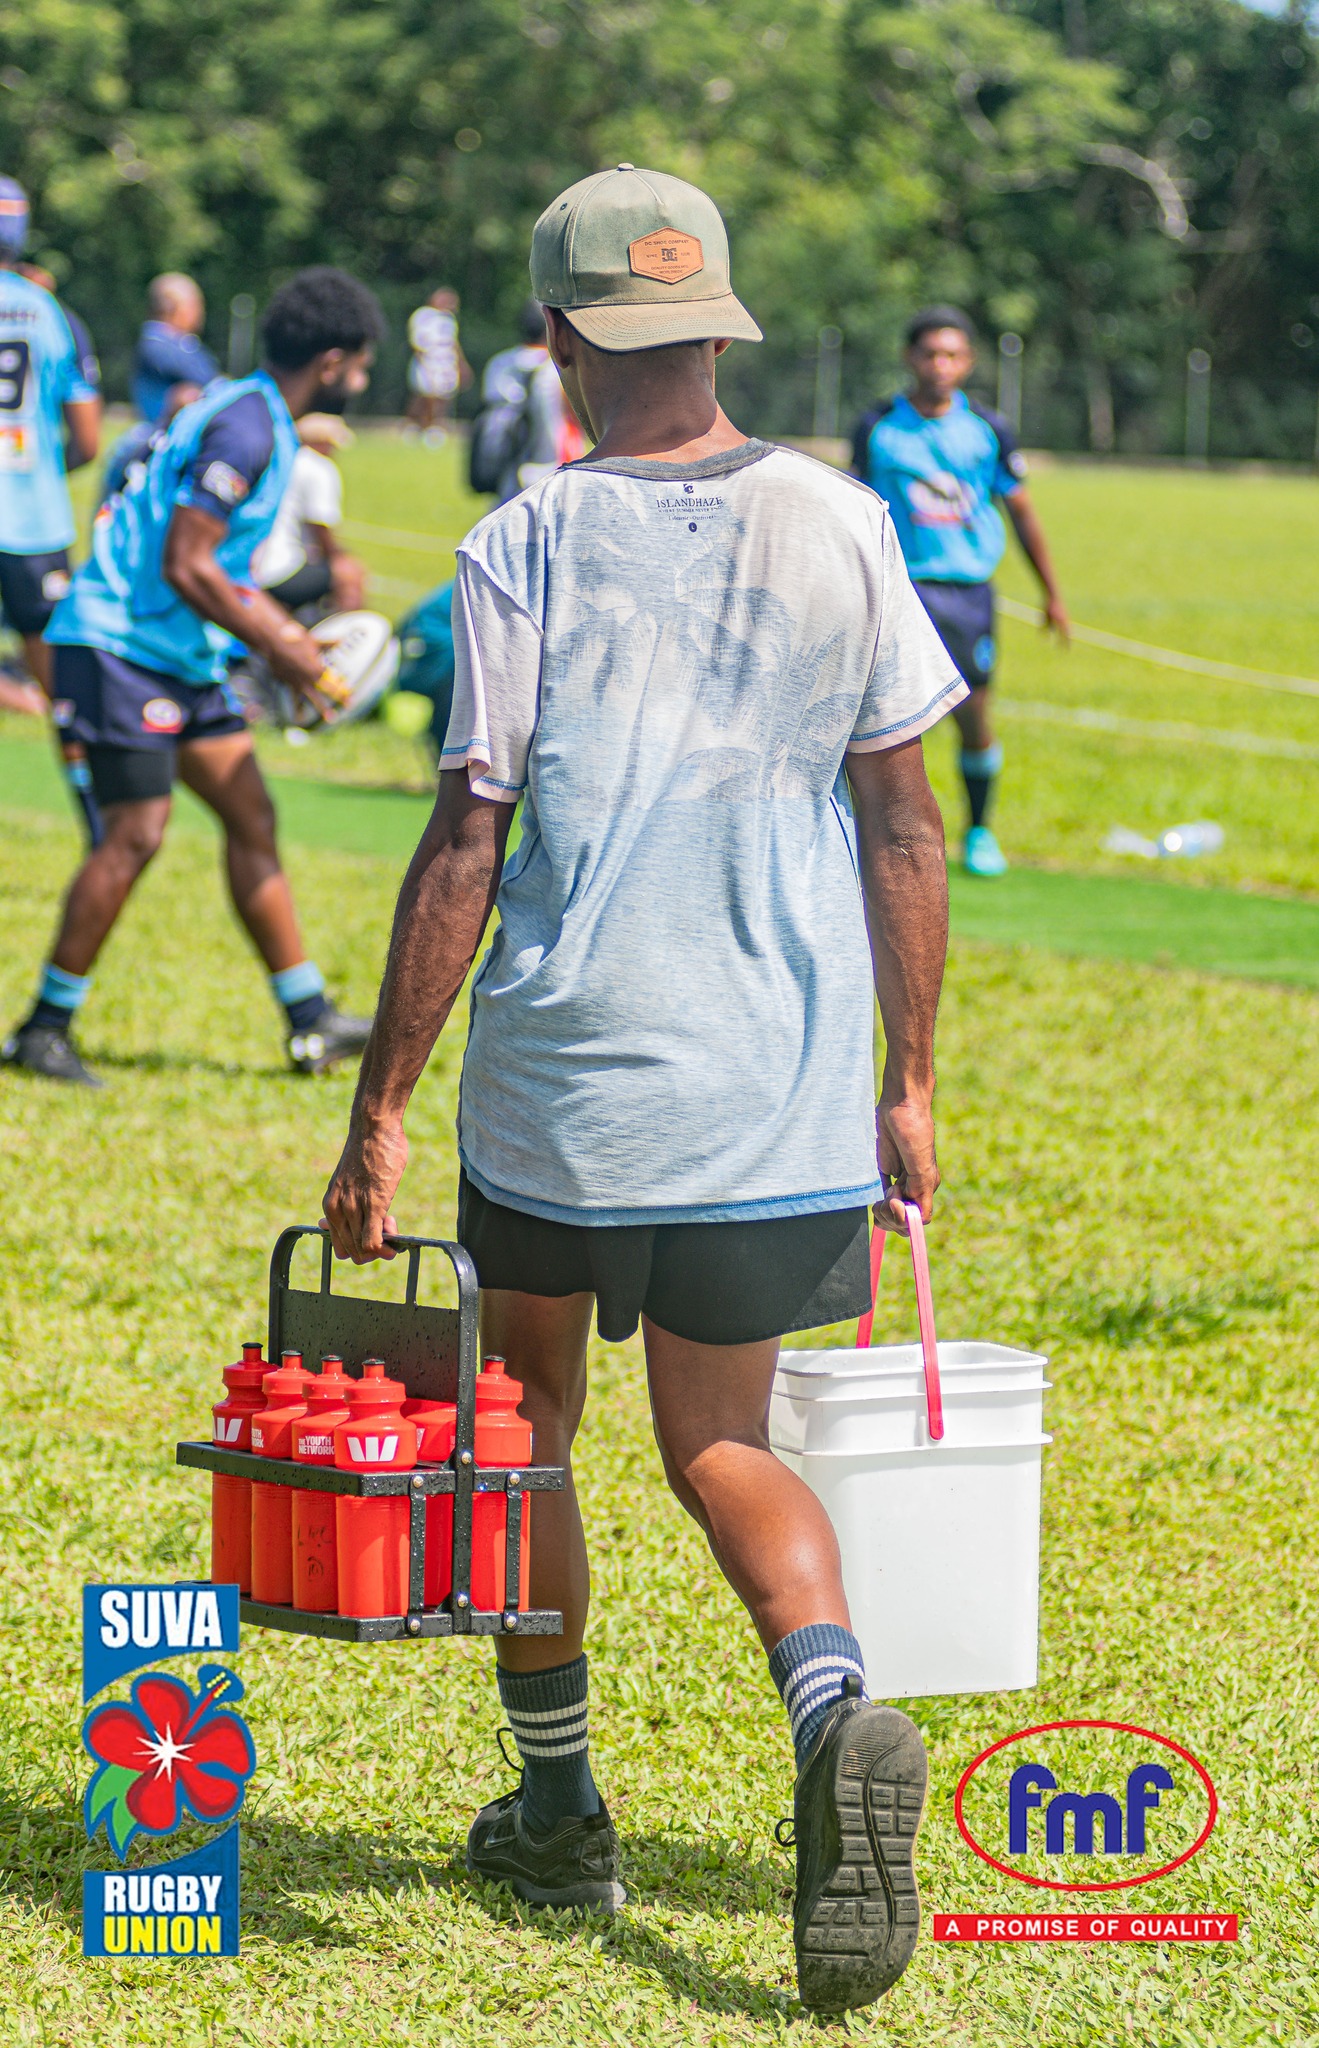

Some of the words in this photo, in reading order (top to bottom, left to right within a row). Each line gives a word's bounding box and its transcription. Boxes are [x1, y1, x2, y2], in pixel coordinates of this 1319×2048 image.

[656, 497, 723, 508] ISLANDHAZE
[305, 1435, 332, 1446] YOUTH
[298, 1444, 335, 1455] NETWORK
